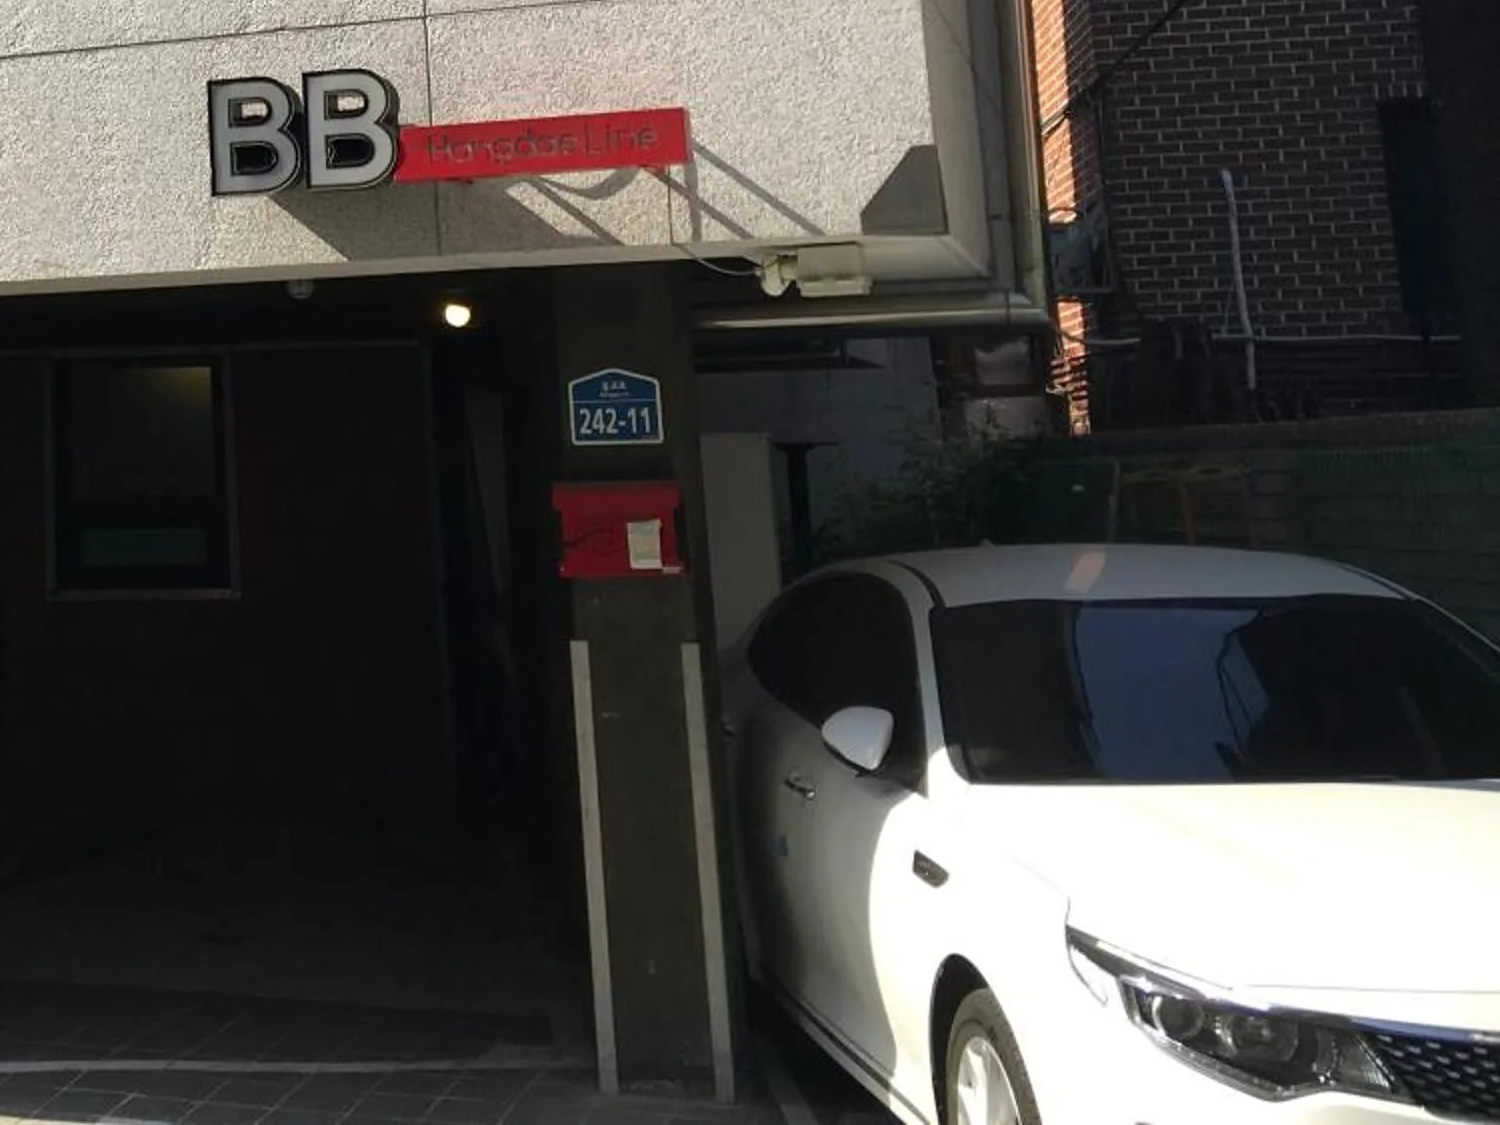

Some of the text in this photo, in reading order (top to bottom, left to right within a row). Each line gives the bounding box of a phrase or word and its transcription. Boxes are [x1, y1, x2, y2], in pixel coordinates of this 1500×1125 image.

[207, 68, 400, 197] BB
[582, 121, 657, 156] Line
[579, 406, 651, 435] 242-11
